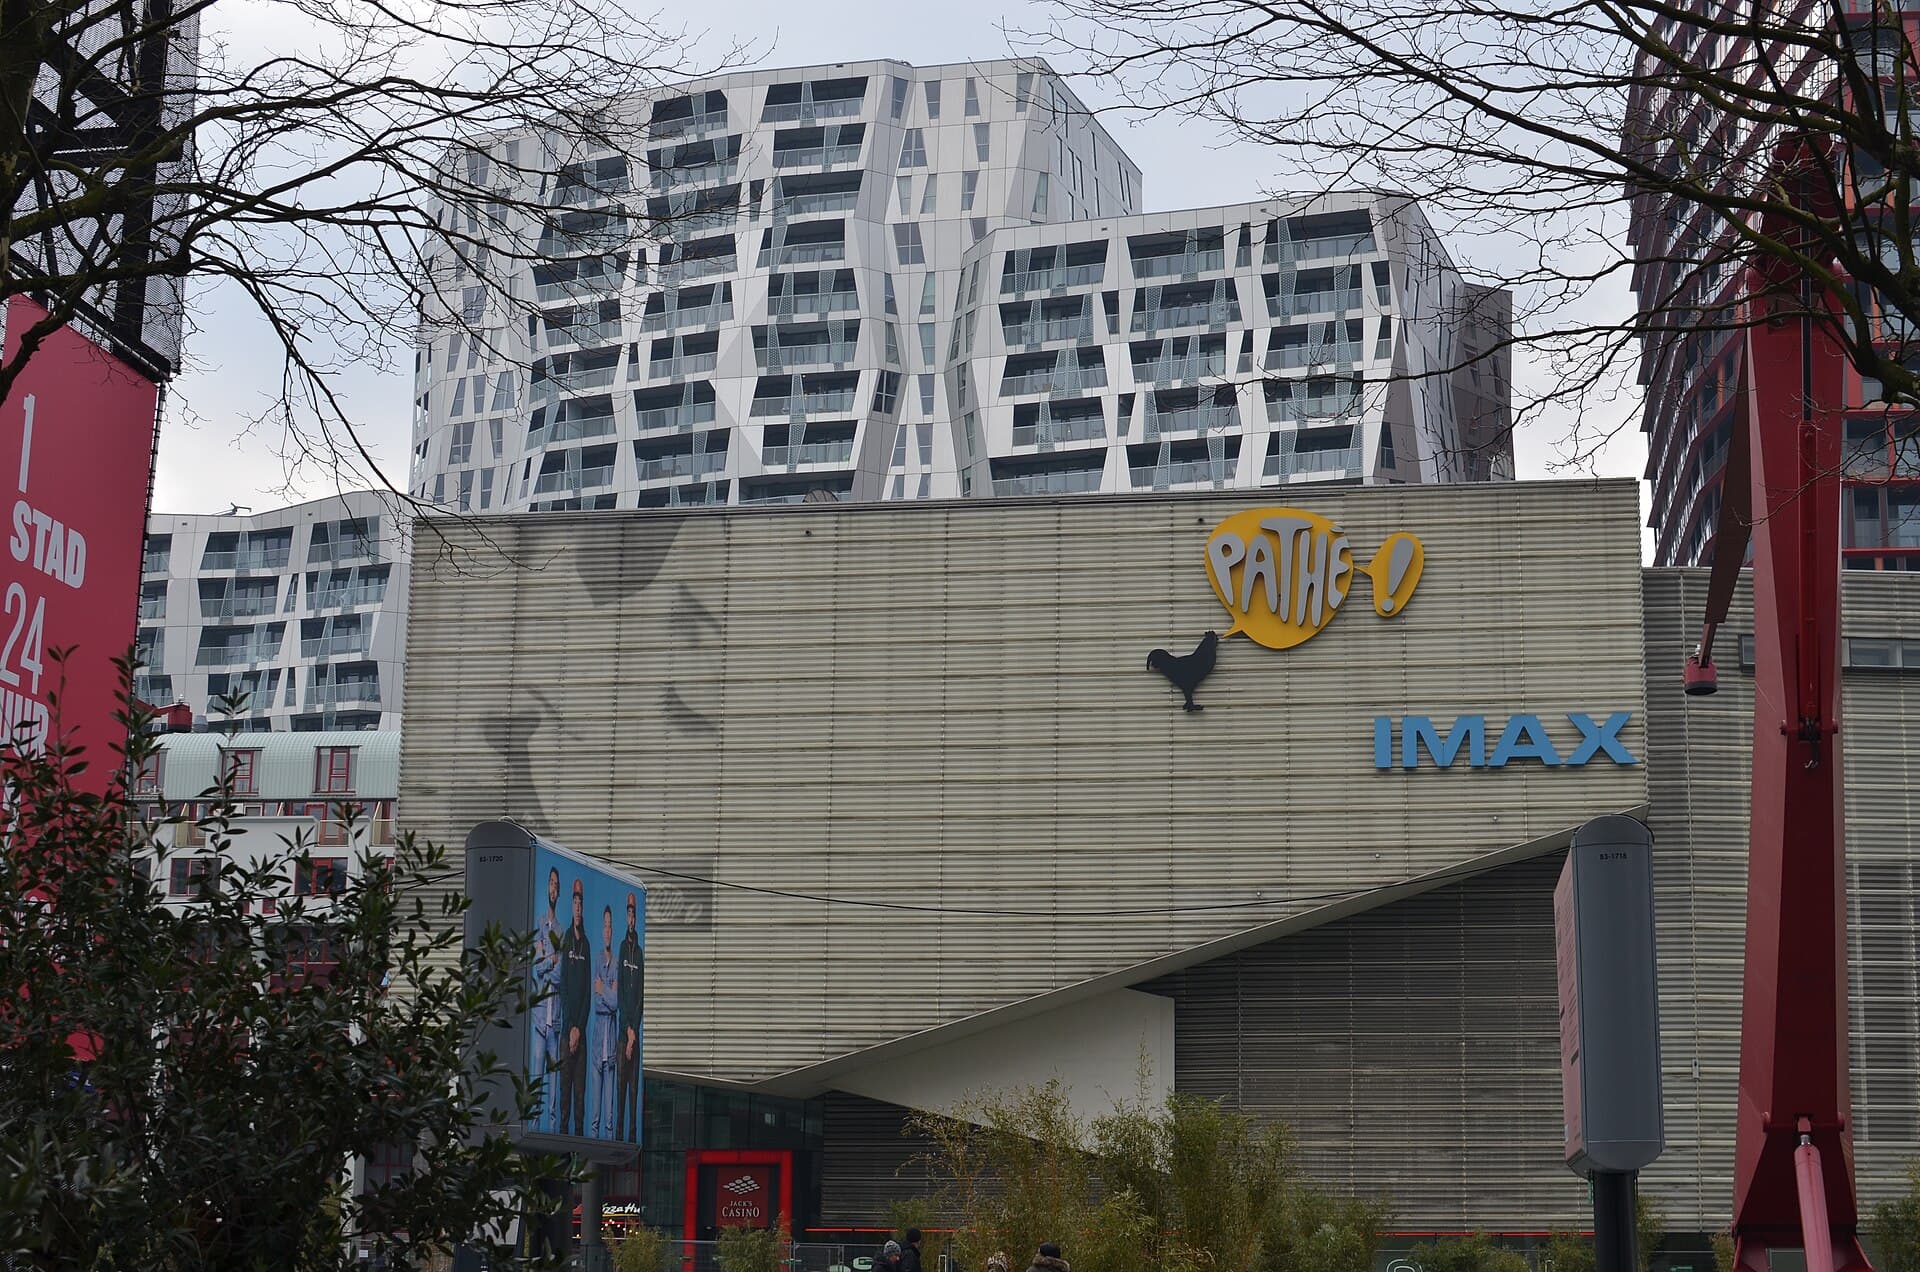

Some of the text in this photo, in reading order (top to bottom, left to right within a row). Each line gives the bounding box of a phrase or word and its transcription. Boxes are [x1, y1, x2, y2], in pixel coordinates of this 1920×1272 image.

[18, 393, 36, 493] 1
[10, 500, 87, 589] STAD
[0, 582, 46, 695] 24
[1374, 712, 1639, 768] IMAX
[722, 1207, 760, 1217] CASINO
